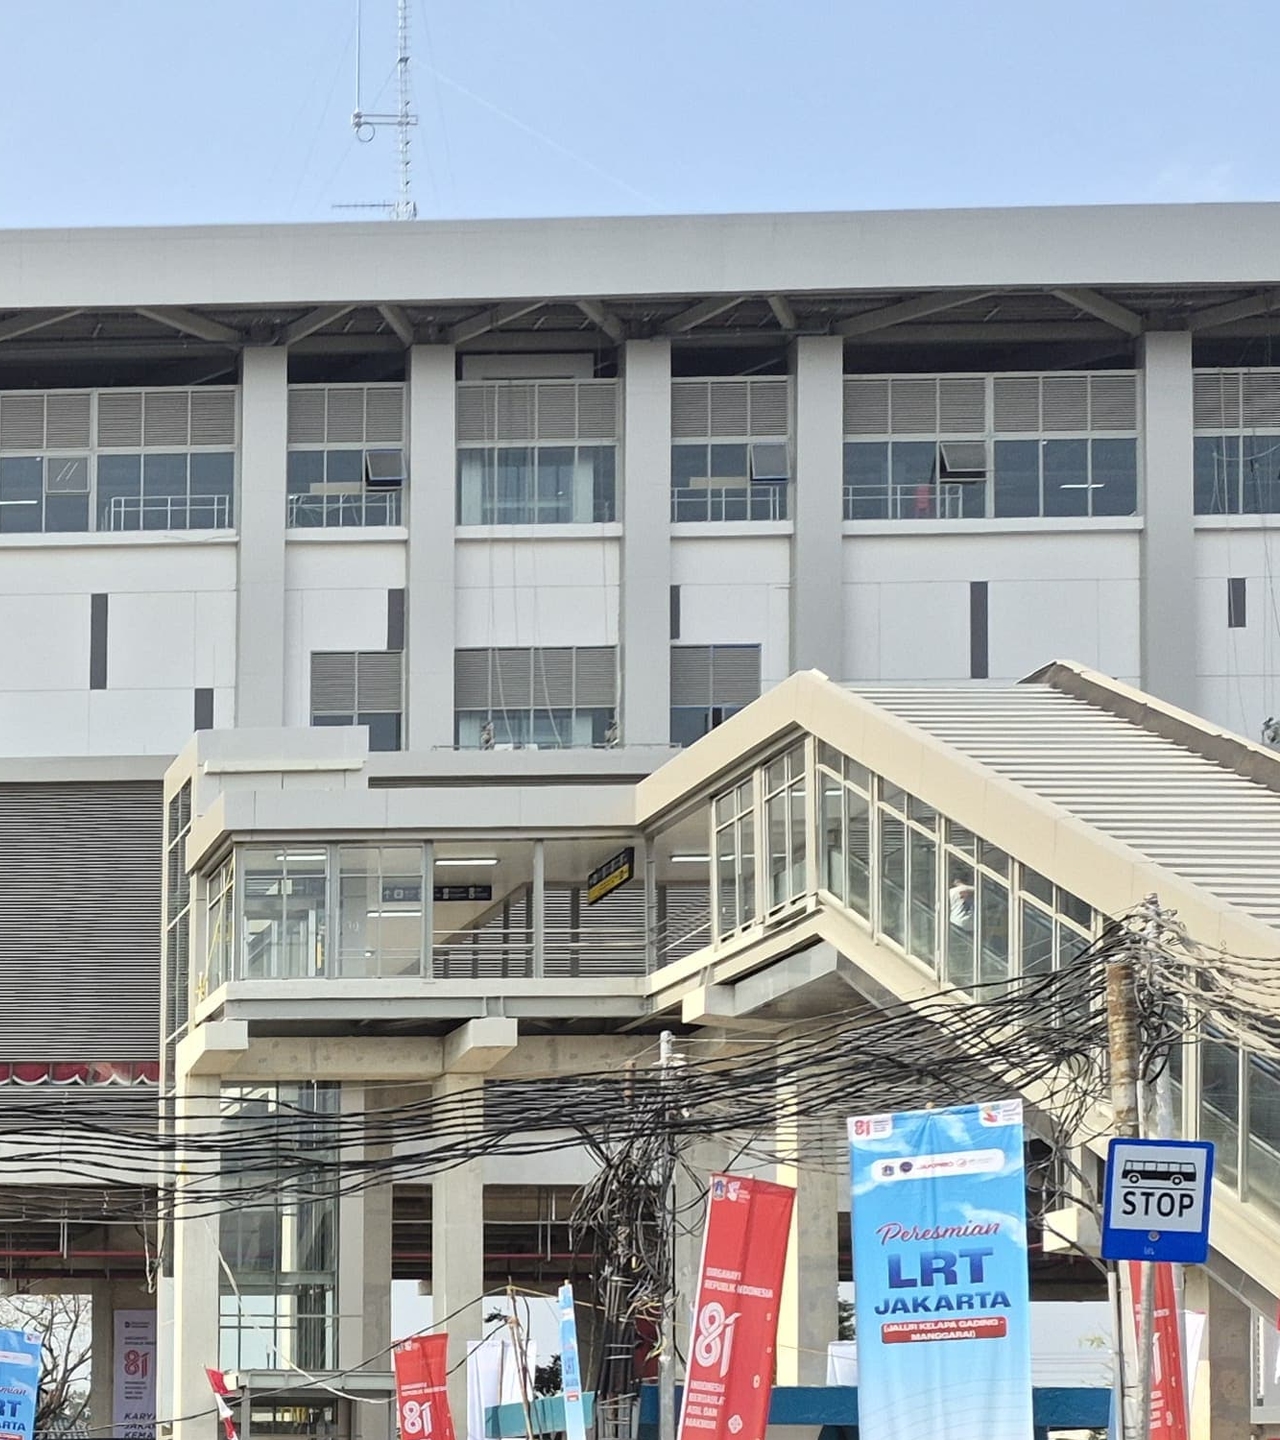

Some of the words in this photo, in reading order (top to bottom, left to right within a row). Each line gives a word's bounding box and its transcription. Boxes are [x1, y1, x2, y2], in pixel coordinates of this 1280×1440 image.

[1122, 1191, 1194, 1218] STOP
[876, 1219, 1000, 1246] Peresmian
[888, 1247, 993, 1289] LRT
[874, 1291, 1011, 1315] JAKARTA
[919, 1321, 956, 1330] KELAPA
[959, 1319, 998, 1327] GADING
[694, 1301, 742, 1378] 81
[124, 1350, 150, 1378] 81
[402, 1400, 432, 1436] 81
